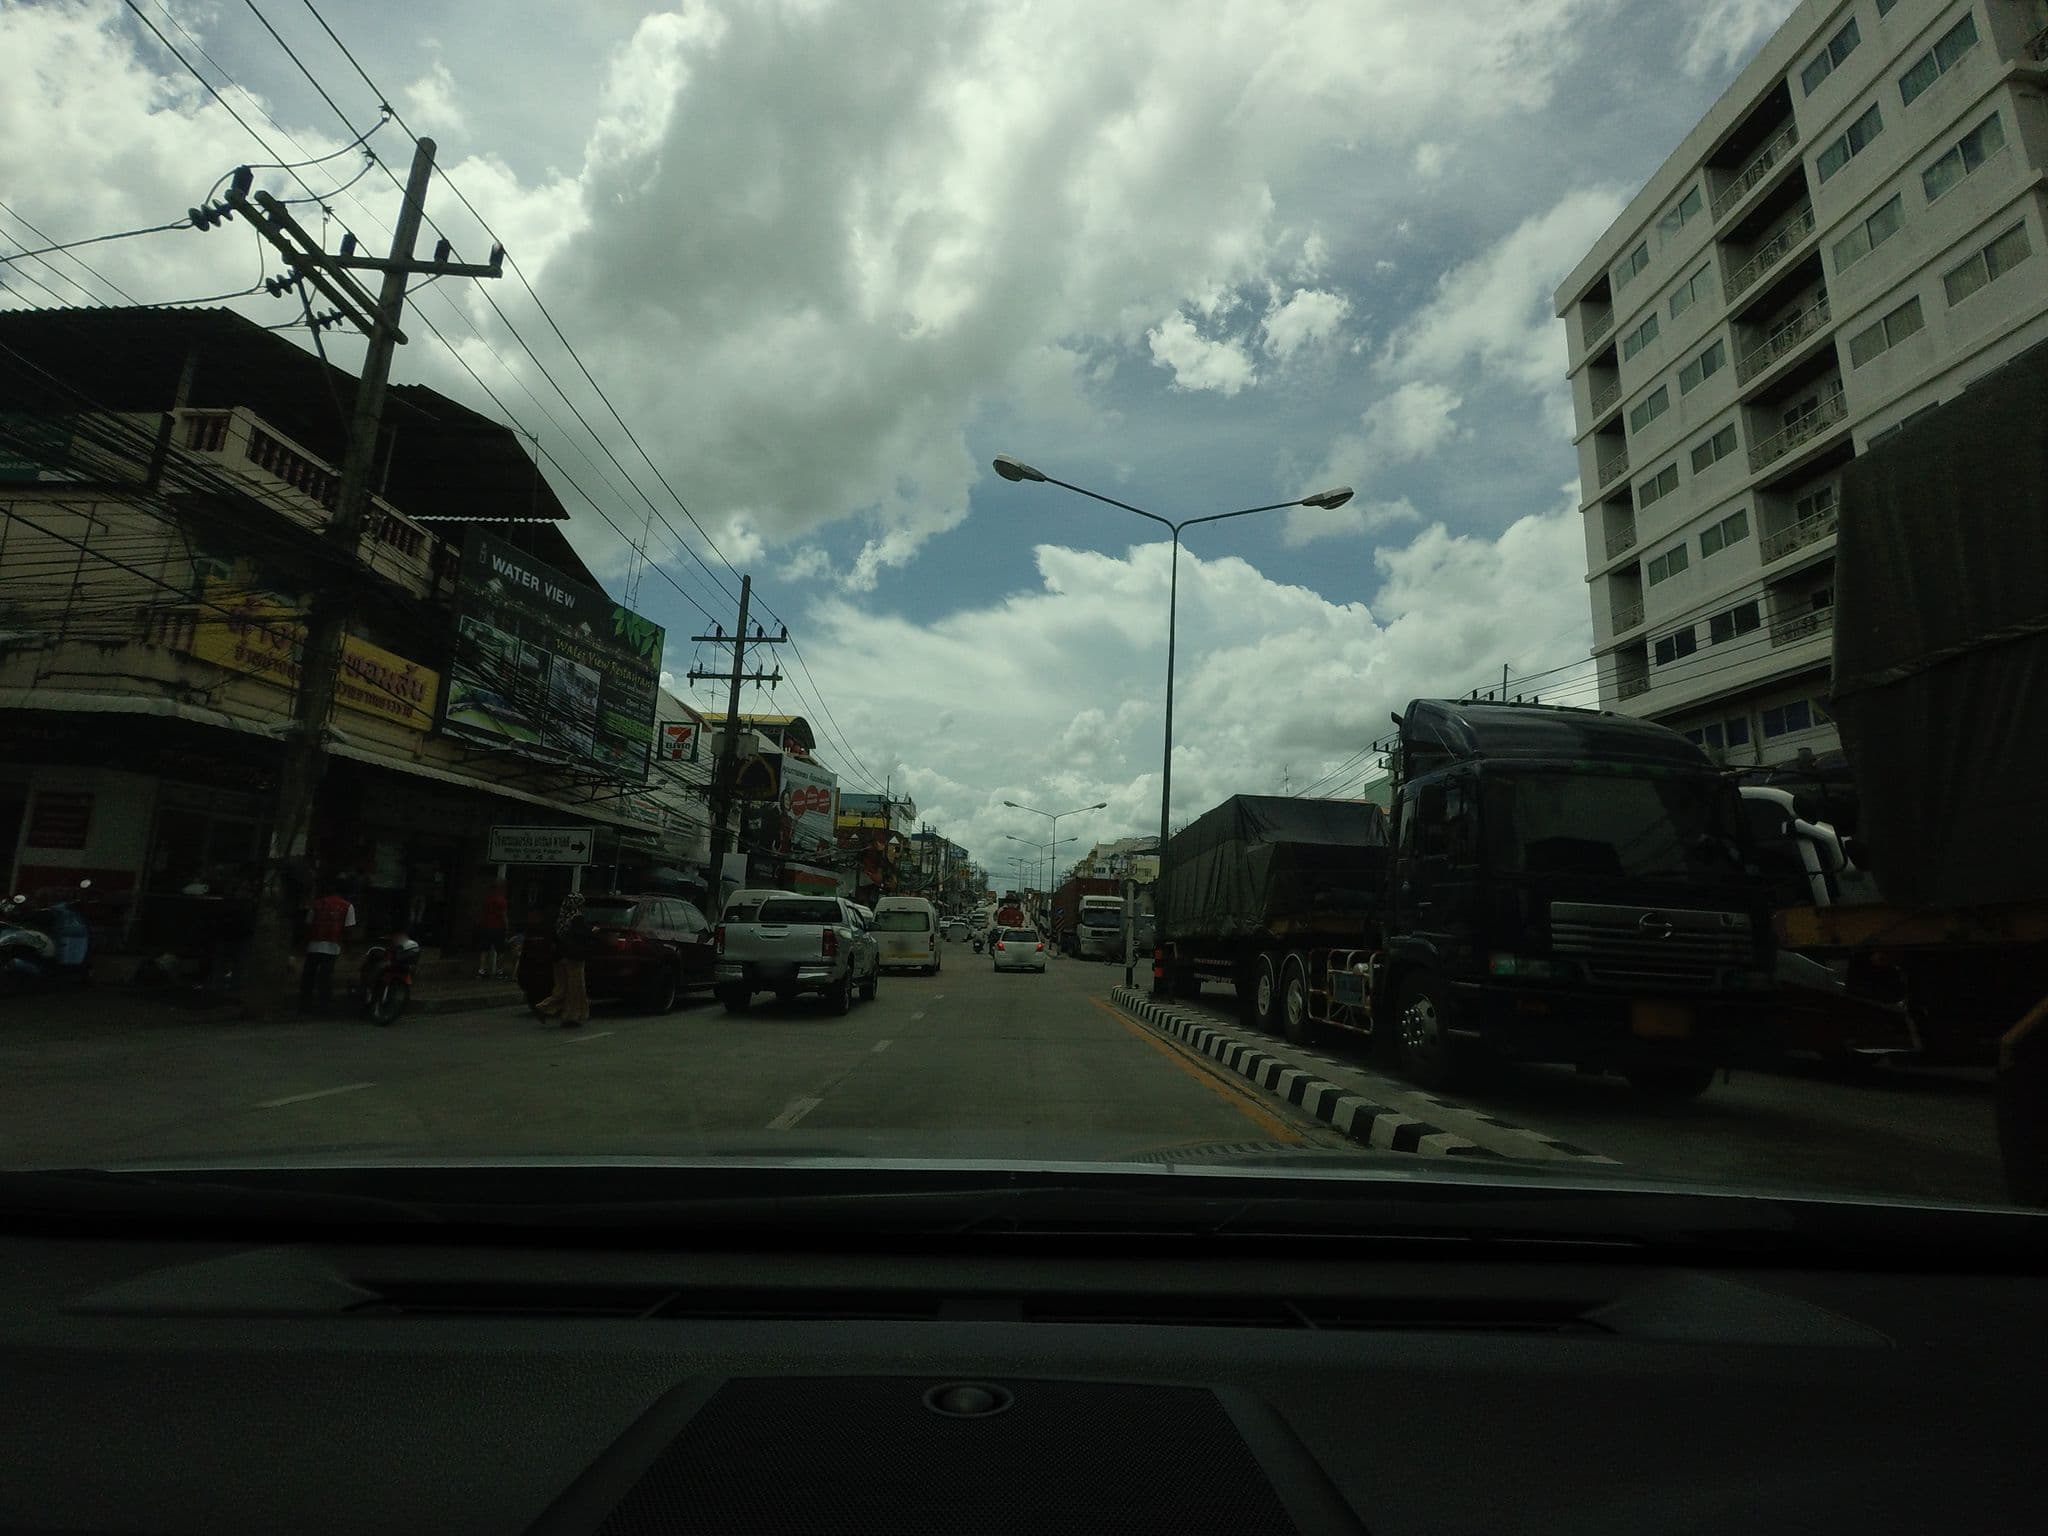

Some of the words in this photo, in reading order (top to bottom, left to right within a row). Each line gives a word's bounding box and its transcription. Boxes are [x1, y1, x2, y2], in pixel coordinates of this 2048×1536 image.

[492, 554, 540, 590] WATER
[546, 582, 576, 608] VIEW
[667, 726, 692, 761] 7
